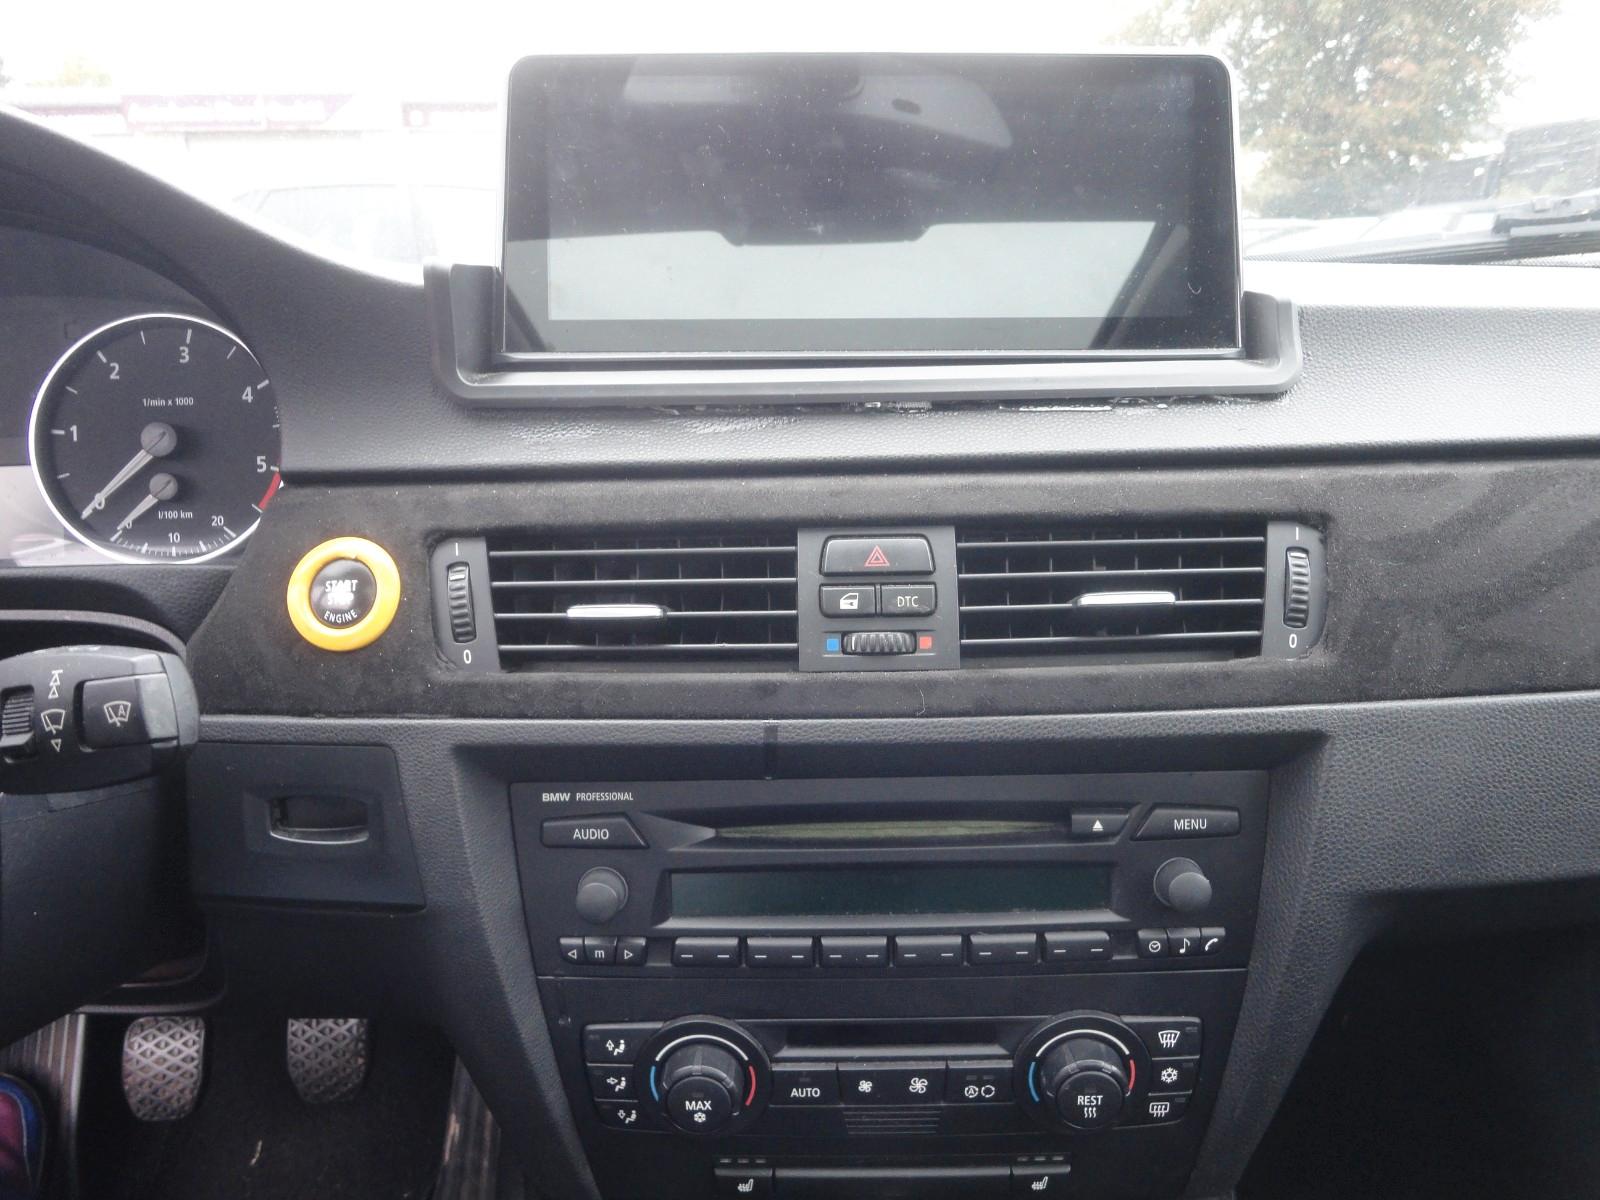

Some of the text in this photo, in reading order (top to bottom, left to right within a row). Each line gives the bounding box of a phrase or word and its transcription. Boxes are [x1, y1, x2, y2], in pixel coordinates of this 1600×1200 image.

[180, 346, 190, 363] 3
[109, 362, 120, 380] 2
[241, 386, 254, 403] 4
[143, 398, 166, 408] 1/min
[175, 397, 194, 406] 1000
[70, 424, 78, 442] 1
[256, 455, 267, 473] 5
[180, 510, 193, 518] km
[211, 516, 224, 527] 20
[168, 532, 181, 543] 10
[325, 580, 358, 592] START
[896, 595, 919, 607] DTC
[323, 609, 358, 623] ENGINE
[541, 791, 634, 802] BMW PROFESSIONAL
[1173, 818, 1207, 831] MENU
[572, 828, 610, 840] AUDIO
[790, 1087, 821, 1098] AUTO
[685, 1099, 712, 1111] MAX
[1077, 1094, 1103, 1106] REST
